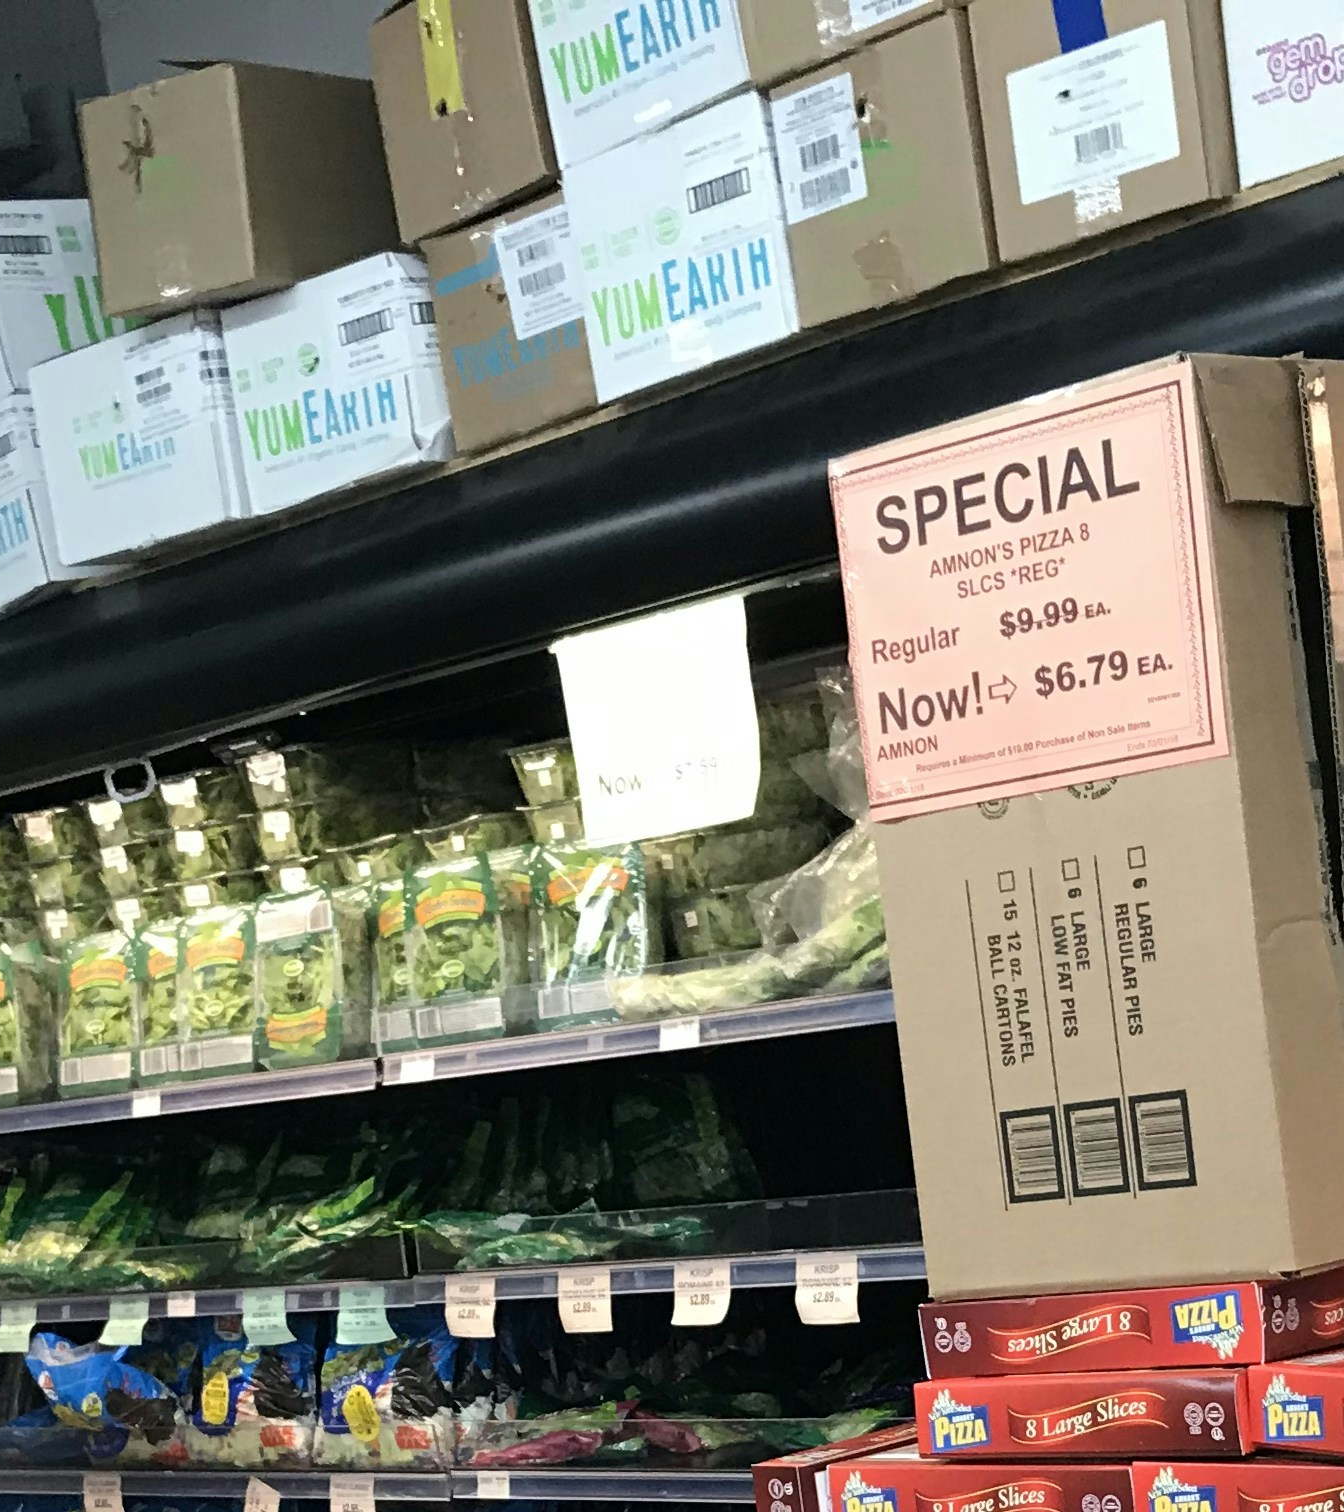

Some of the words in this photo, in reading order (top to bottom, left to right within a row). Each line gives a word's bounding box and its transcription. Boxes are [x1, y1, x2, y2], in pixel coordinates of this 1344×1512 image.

[245, 378, 397, 462] YUMEARTH
[874, 438, 1141, 555] SPECIAL
[929, 542, 1014, 579] AMNON'S
[1019, 528, 1074, 557] PIZZA
[1079, 523, 1090, 541] 8
[956, 573, 1006, 600] SLCS
[870, 625, 960, 664] Regular
[999, 597, 1078, 640] $9.99
[1084, 602, 1112, 619] EA.
[877, 670, 984, 735] Now!
[1034, 650, 1129, 700] $6.79
[1137, 651, 1173, 677] EA.
[875, 734, 939, 763] AMNON
[1067, 888, 1082, 899] 6
[1133, 876, 1148, 889] 6
[1003, 899, 1018, 922] 15
[1006, 931, 1022, 955] 12
[1050, 914, 1067, 957] LOW
[1070, 910, 1091, 972] LARGE
[1114, 903, 1139, 989] REGULAR
[1135, 902, 1156, 964] LARGE
[987, 934, 1007, 979] BALL
[1055, 962, 1074, 993] FAT
[993, 984, 1016, 1067] CARTONS
[1013, 987, 1036, 1064] FALAFEL
[1061, 998, 1079, 1039] PIES
[1126, 994, 1143, 1037] PIES
[1062, 1313, 1113, 1341] Large
[1120, 1311, 1131, 1330] 8
[1175, 1295, 1237, 1330] PIZZA
[1008, 1332, 1058, 1355] Slices
[934, 1418, 987, 1448] PIZZA
[1025, 1419, 1037, 1438] 8
[1042, 1413, 1092, 1438] Large
[1096, 1398, 1147, 1422] Slices
[1268, 1403, 1321, 1439] PIZZA
